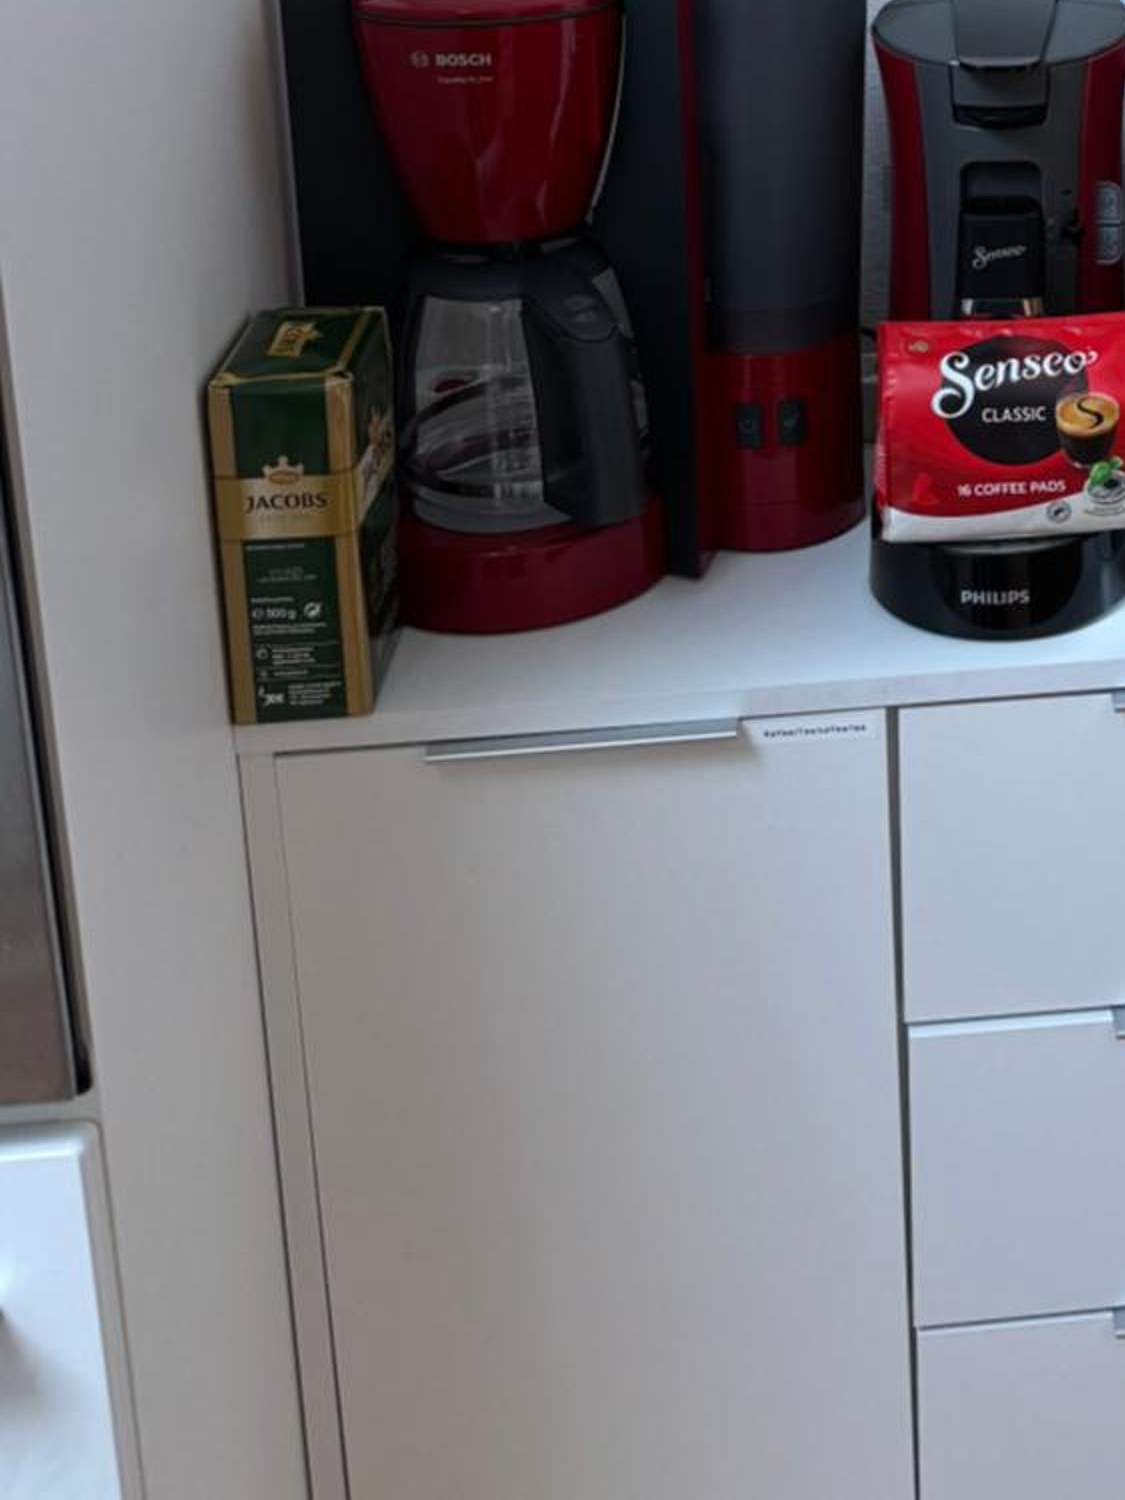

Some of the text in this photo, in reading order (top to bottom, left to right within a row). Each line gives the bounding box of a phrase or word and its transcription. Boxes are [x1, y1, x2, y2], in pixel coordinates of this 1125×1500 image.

[435, 52, 493, 67] BOSCH
[930, 350, 1099, 419] Senseo
[981, 405, 1047, 423] CLASSIC
[957, 479, 1067, 497] 16 COFFEE PADS
[246, 491, 328, 514] JACOBS
[961, 588, 1031, 606] PHILIPS
